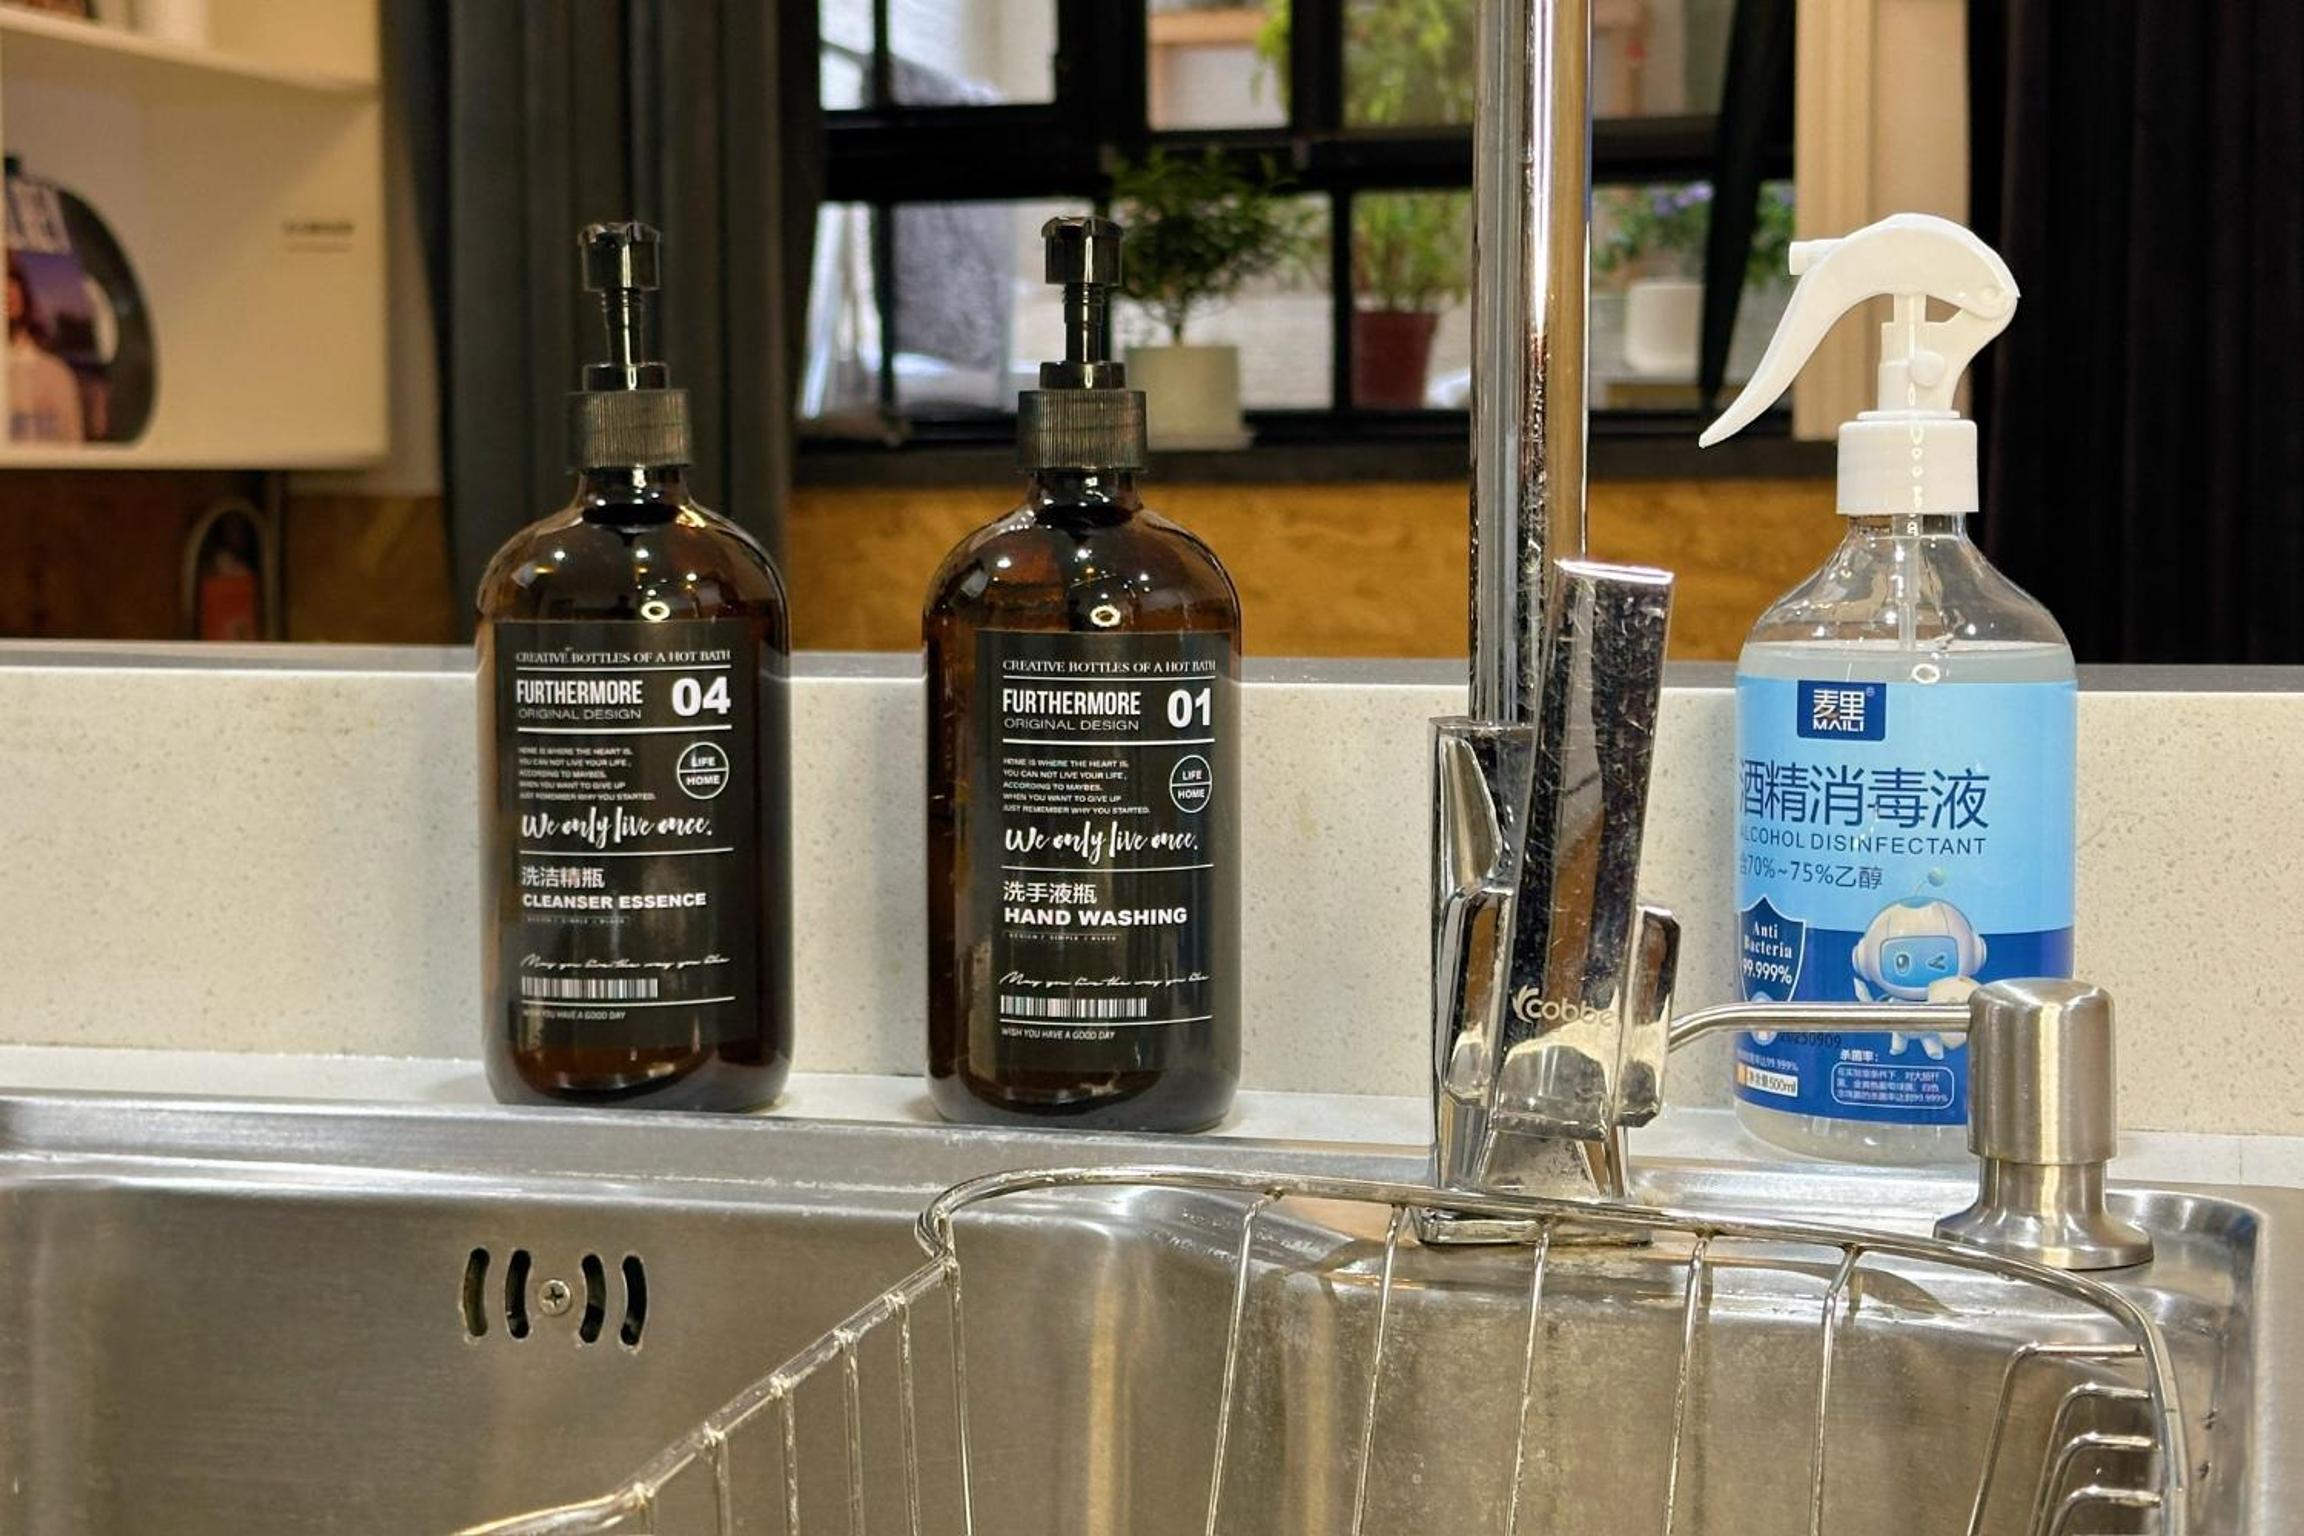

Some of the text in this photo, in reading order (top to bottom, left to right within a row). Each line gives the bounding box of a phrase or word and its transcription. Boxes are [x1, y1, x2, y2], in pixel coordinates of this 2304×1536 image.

[516, 650, 731, 664] CREATIVE BOTTLES OF A HOT BATH
[1002, 659, 1216, 673] CREATIVE BOTTLES OF A HOT BATH
[516, 679, 644, 705] FURTHERMORE
[672, 675, 731, 717] 04
[1002, 688, 1142, 715] FURTHERMORE
[1167, 687, 1211, 728] 01
[1813, 689, 1866, 720] 麦里
[518, 708, 642, 720] ORIGINAL DESIGN
[1004, 718, 1139, 731] ORIGINAL DESIGN
[1813, 718, 1864, 732] MAILI
[691, 756, 716, 768] LIFE
[1070, 760, 1087, 768] THE
[1089, 760, 1117, 769] HEART
[686, 775, 720, 786] HOME
[1003, 769, 1019, 778] YOU
[1021, 770, 1039, 778] CAN
[1040, 770, 1058, 779] NOT
[1059, 771, 1078, 780] LIVE
[1080, 771, 1104, 780] YOUR
[1182, 769, 1202, 781] LIFE
[1053, 783, 1065, 791] TO
[1177, 789, 1205, 800] HOME
[1741, 759, 1990, 831] 酒精消毒液
[1047, 794, 1072, 802] WANT
[1075, 795, 1086, 803] TO
[1087, 795, 1107, 803] GIVE
[1109, 795, 1121, 803] UP
[1092, 807, 1110, 815] YOU
[521, 806, 713, 849] We only live once.
[1005, 821, 1198, 865] We only live once.
[1811, 833, 1987, 856] DISINFECTANT
[522, 865, 606, 889] 洗洁精瓶
[1003, 880, 1098, 905] 洗手液瓶
[523, 892, 707, 910] CLEANSER ESSENCE
[1004, 907, 1188, 927] HAND WASHING
[1753, 921, 1778, 939] Anti
[1743, 958, 1792, 985] 99.999%
[1024, 1028, 1040, 1038] YOU
[1042, 1029, 1063, 1039] HAVE
[1065, 1030, 1071, 1039] A
[1072, 1030, 1097, 1040] GOOD
[1098, 1031, 1115, 1040] DAY
